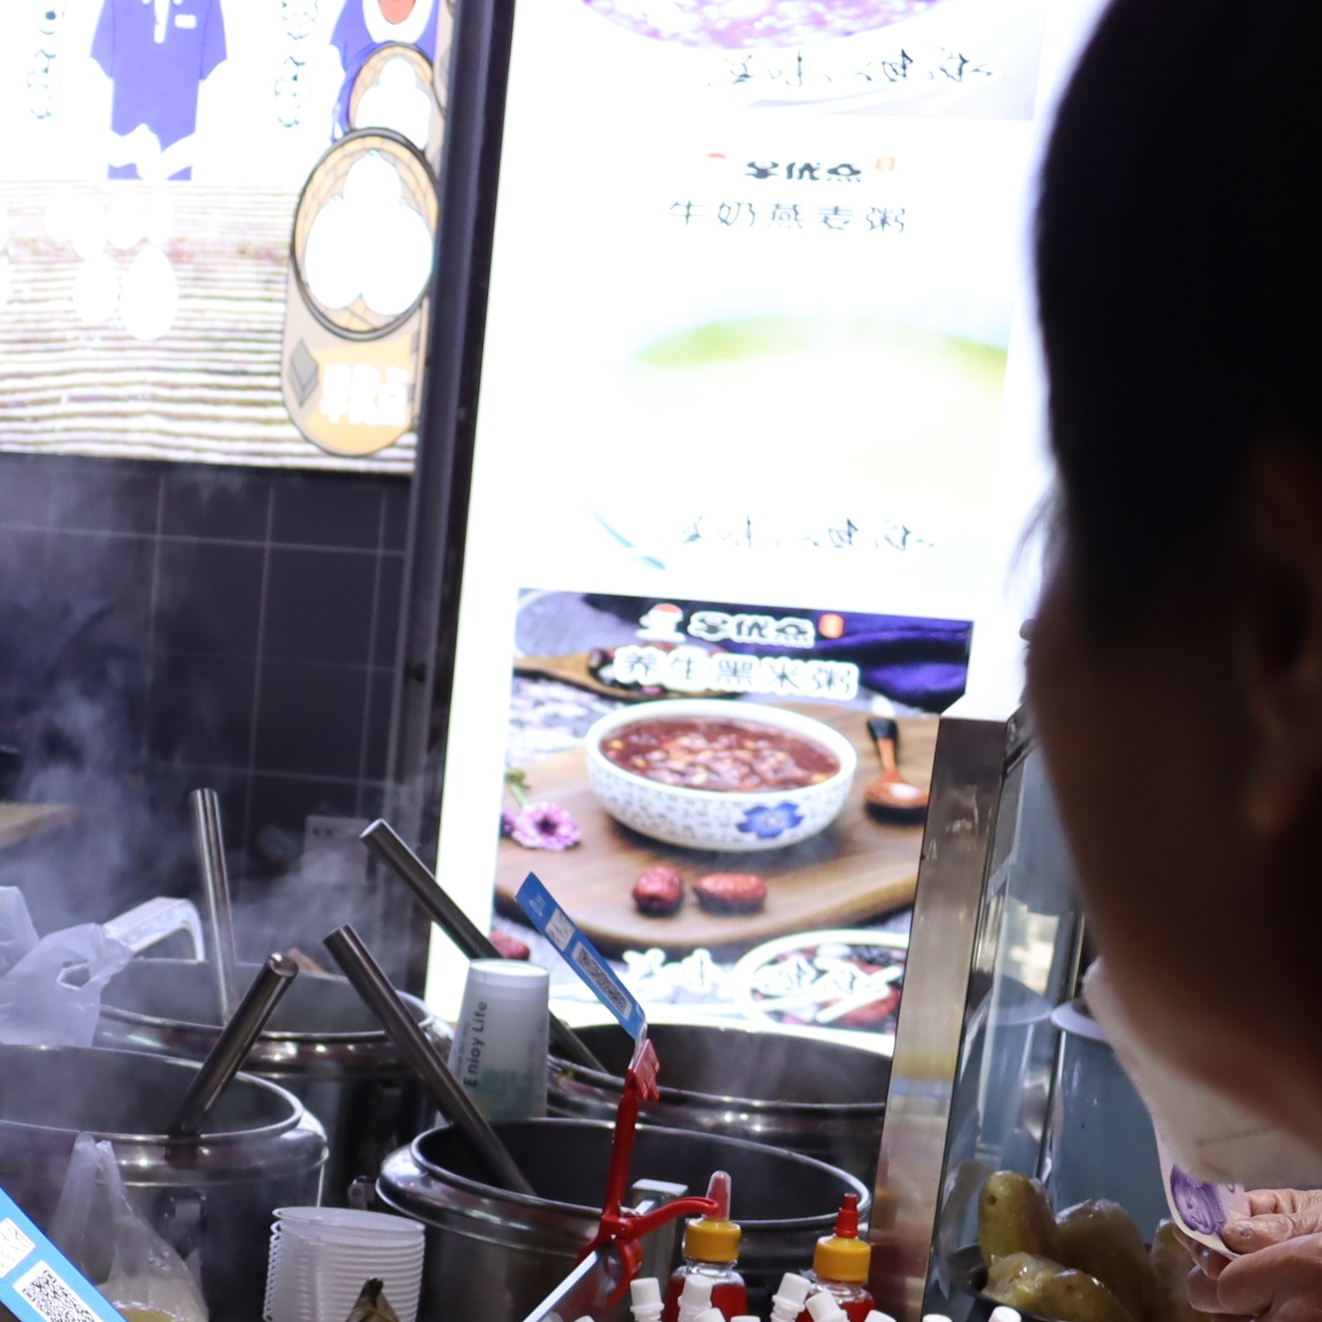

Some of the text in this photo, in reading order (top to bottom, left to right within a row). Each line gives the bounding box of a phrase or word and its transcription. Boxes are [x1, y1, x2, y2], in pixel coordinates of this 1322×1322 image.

[668, 200, 906, 233] 牛奶燕麦粥
[619, 649, 855, 697] 养生黑米粥
[463, 1001, 488, 1087] Enjoy Life
